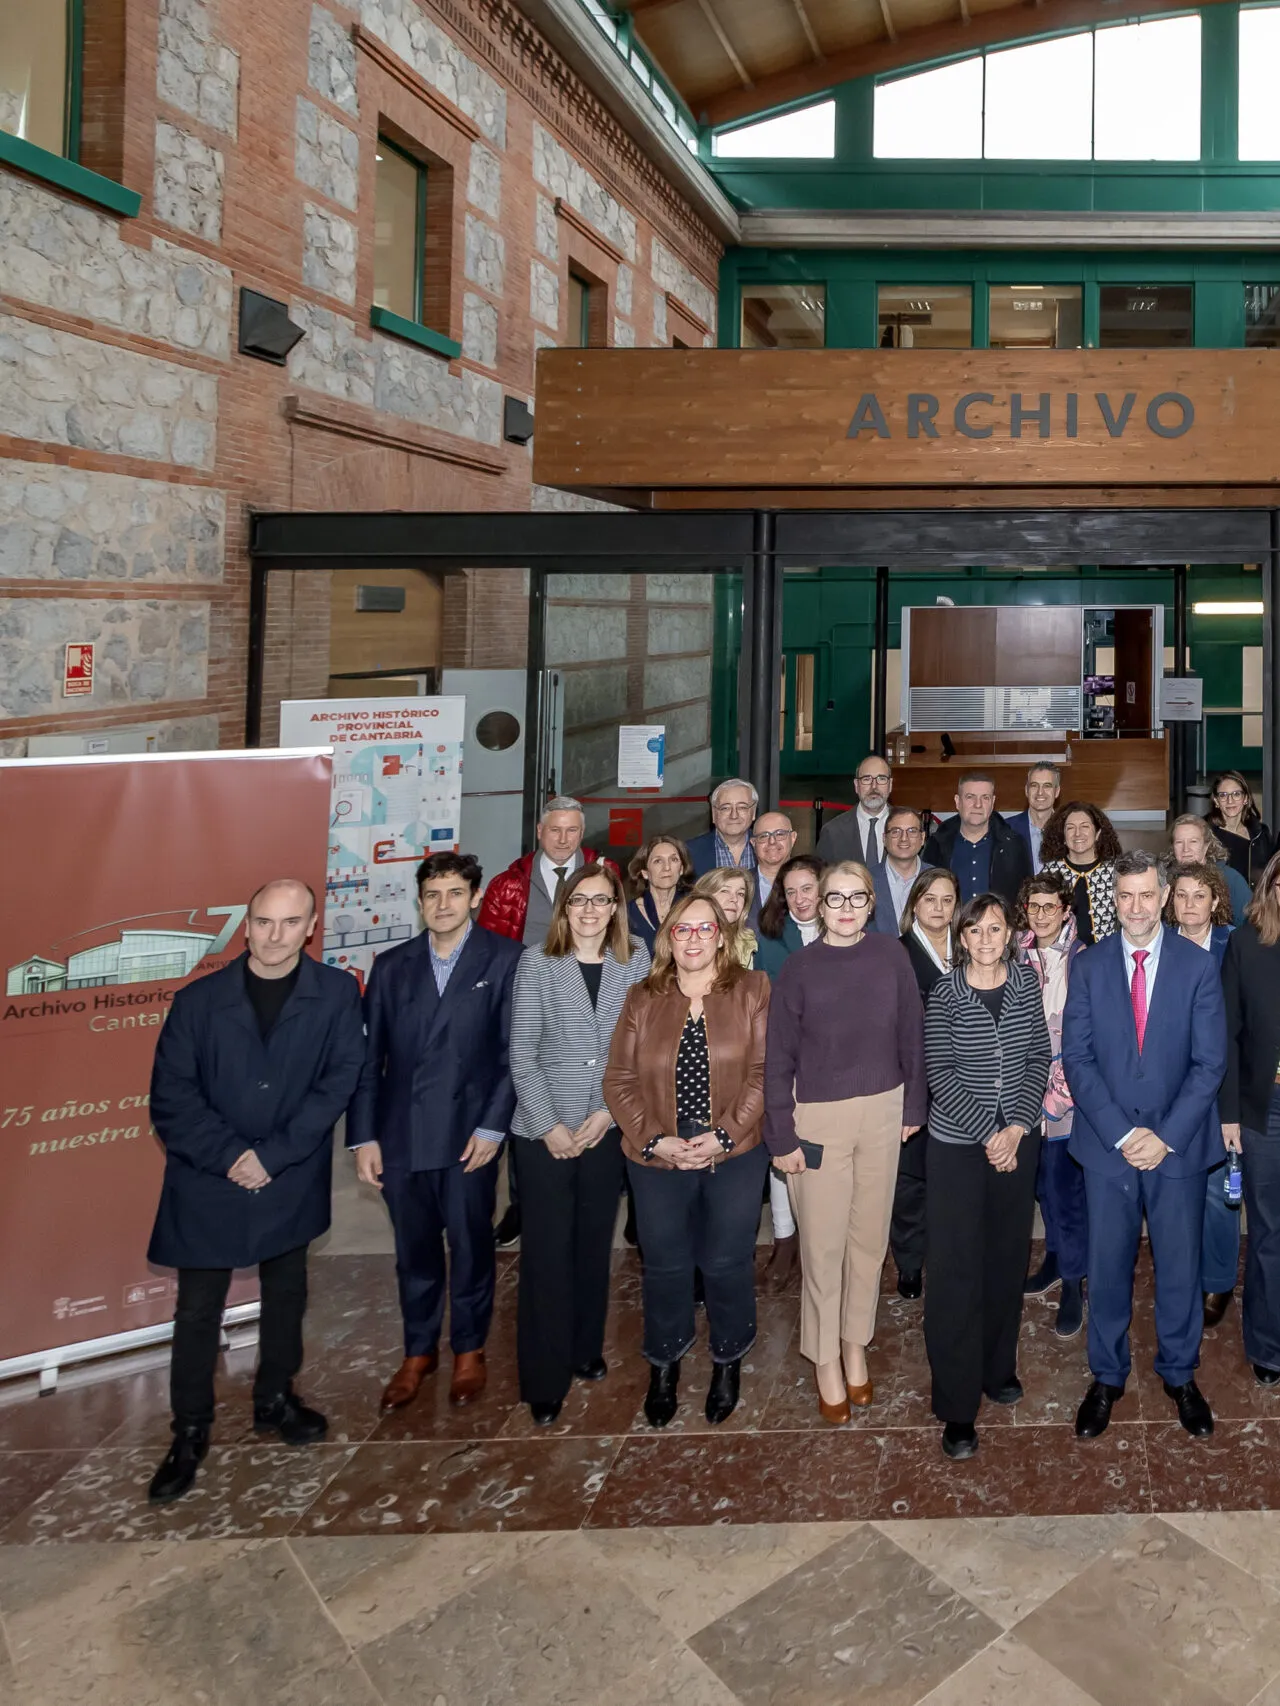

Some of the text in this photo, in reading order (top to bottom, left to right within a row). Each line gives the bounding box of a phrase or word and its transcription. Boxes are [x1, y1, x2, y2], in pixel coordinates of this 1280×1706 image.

[845, 391, 1196, 439] ARCHIVO
[310, 708, 440, 722] ARCHIVO HISTÓRICO
[336, 720, 414, 732] PROVINCIAL
[329, 731, 423, 743] DE CANTABRIA
[3, 1000, 86, 1021] Archivo
[1, 1106, 35, 1129] 75
[41, 1099, 110, 1123] años
[29, 1125, 140, 1156] nuestra
